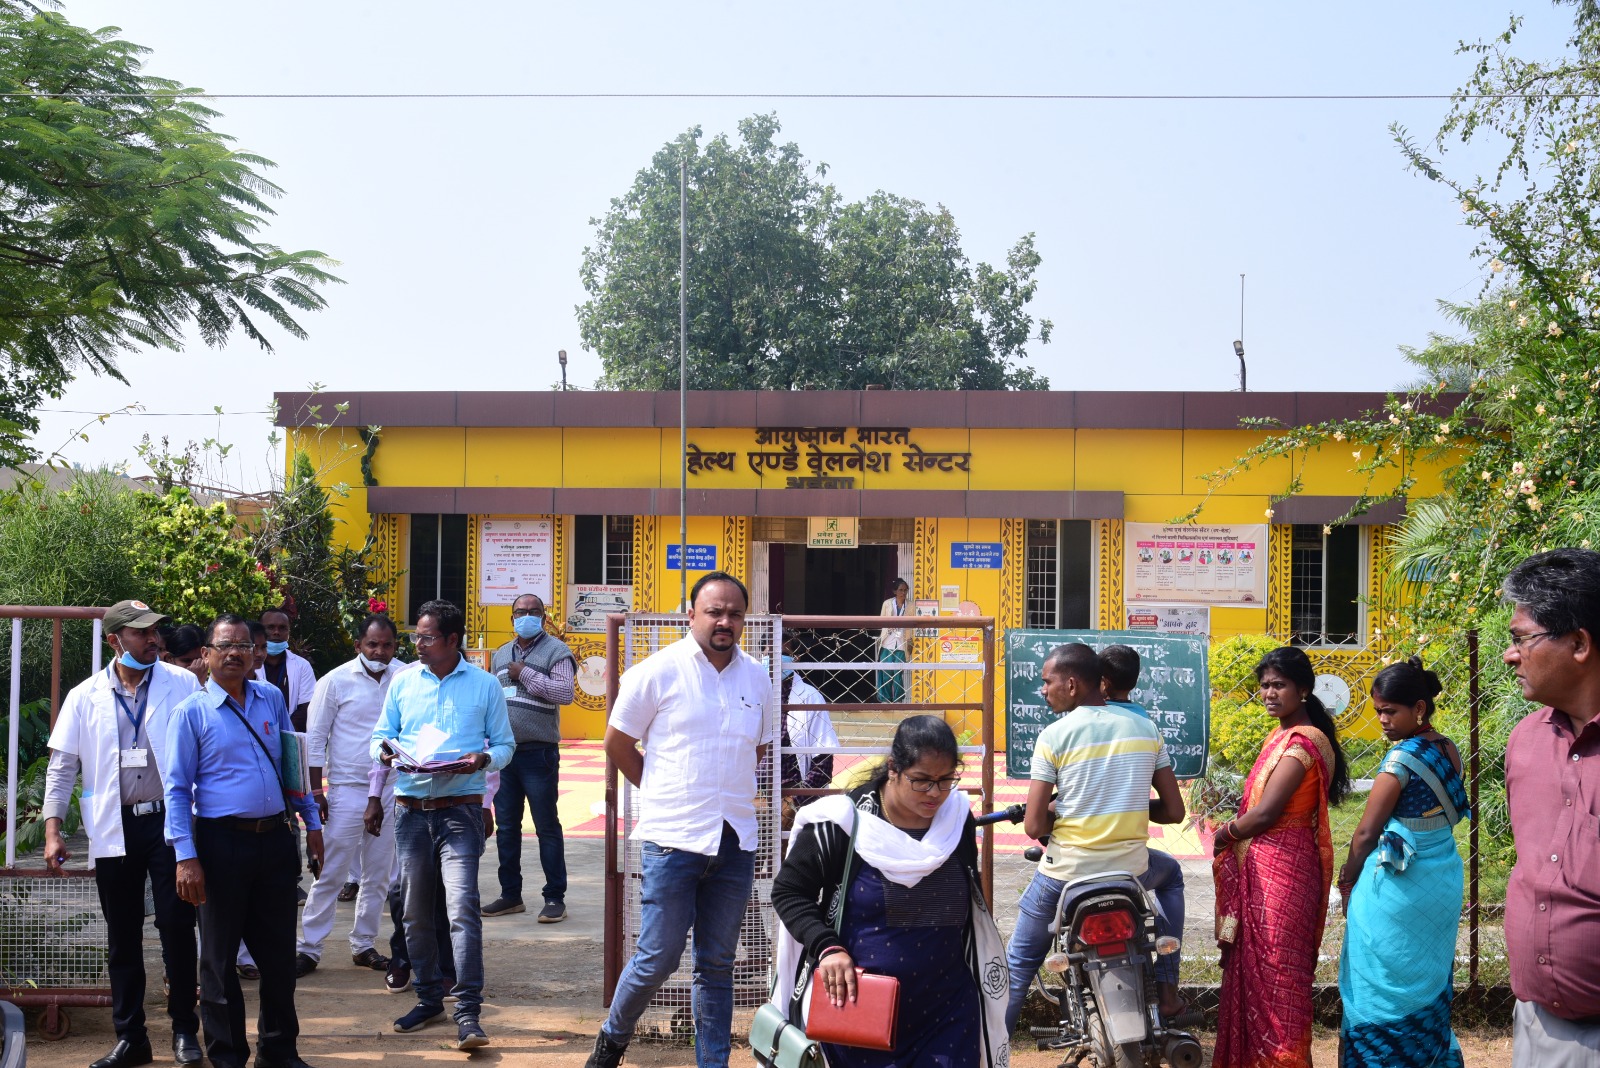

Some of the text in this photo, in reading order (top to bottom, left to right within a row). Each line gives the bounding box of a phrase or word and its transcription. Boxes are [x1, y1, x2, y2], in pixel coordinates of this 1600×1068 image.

[755, 426, 911, 450] आयुष्मान भारत
[686, 444, 736, 475] हेल्थ
[902, 444, 971, 474] सेन्टर
[1164, 710, 1187, 726] तक
[1098, 900, 1115, 908] Hero
